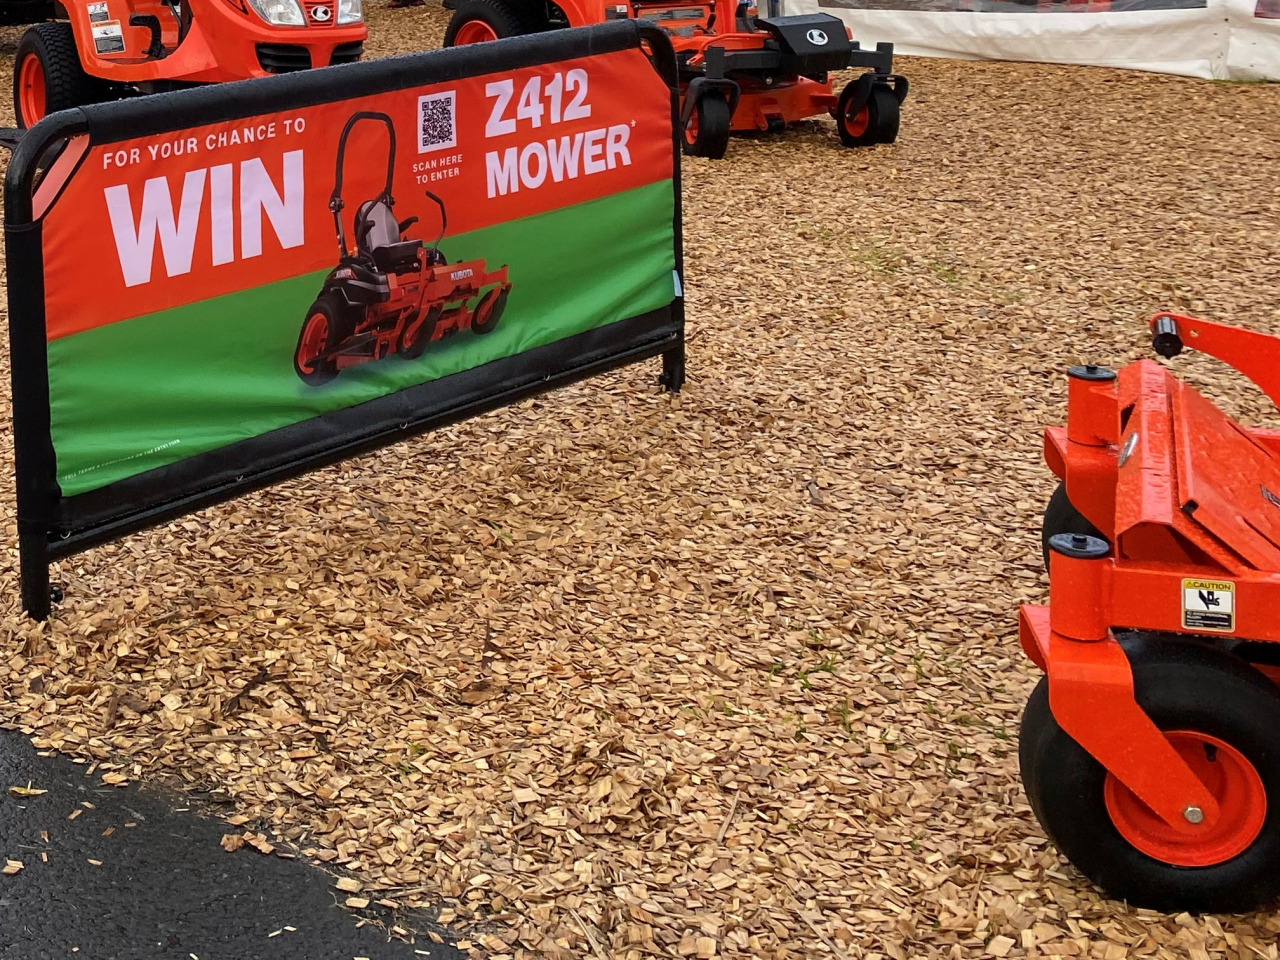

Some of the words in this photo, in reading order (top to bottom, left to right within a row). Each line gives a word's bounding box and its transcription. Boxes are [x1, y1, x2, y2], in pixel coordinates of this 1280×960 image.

[485, 68, 592, 138] Z412
[103, 148, 140, 169] FOR
[148, 137, 198, 161] YOUR
[205, 122, 276, 150] CHANCE
[283, 118, 306, 135] TO
[412, 159, 437, 173] SCAN
[439, 154, 463, 167] HERE
[416, 174, 428, 185] TO
[431, 167, 460, 182] ENTER
[104, 149, 304, 288] WIN
[335, 269, 351, 278] KUBOTA
[451, 269, 473, 281] KUBOTA
[154, 444, 168, 452] ENTRY
[1193, 581, 1231, 590] CAUTION
